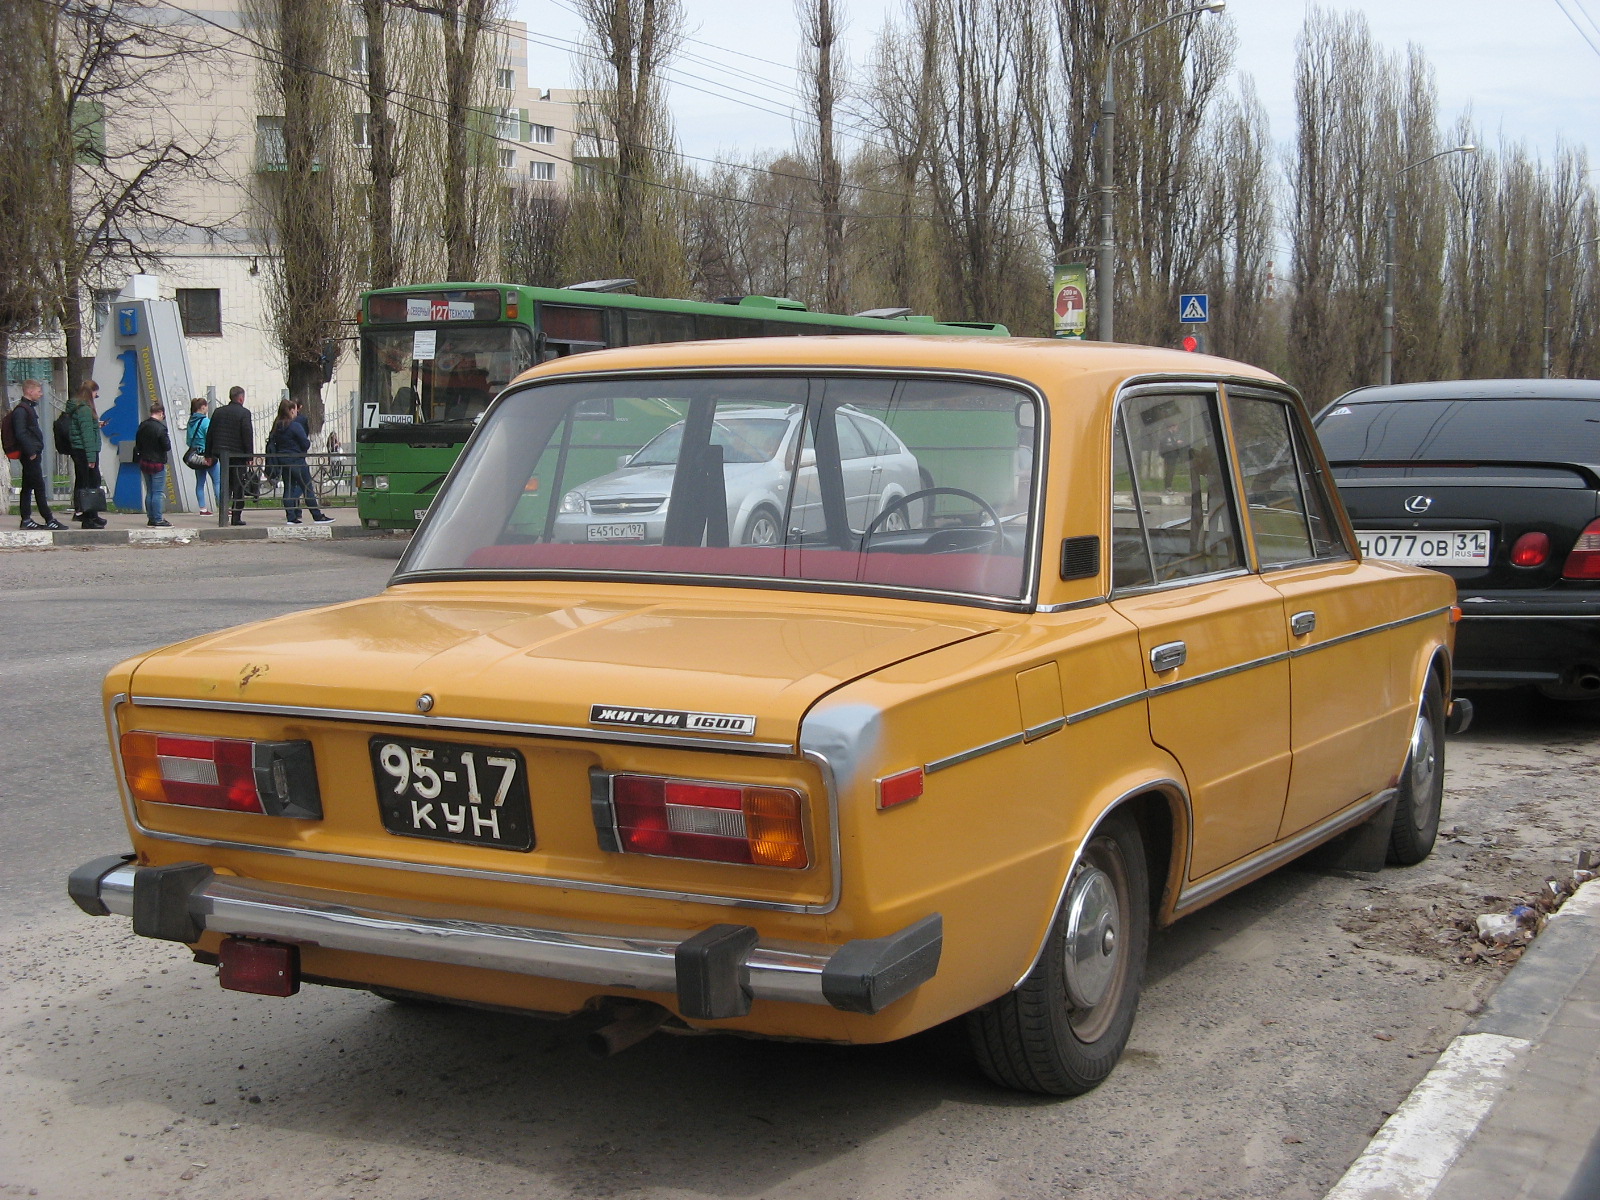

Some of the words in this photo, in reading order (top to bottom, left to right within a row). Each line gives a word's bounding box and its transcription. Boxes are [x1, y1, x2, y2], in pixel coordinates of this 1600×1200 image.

[431, 304, 449, 320] 127
[142, 345, 158, 404] Технологи
[366, 404, 377, 428] 7
[627, 524, 642, 533] 197
[1456, 534, 1480, 551] 31
[597, 709, 681, 725] ЖИГУЛИ
[692, 715, 746, 730] 1600
[379, 743, 517, 807] 95-17
[410, 800, 501, 840] КУН
